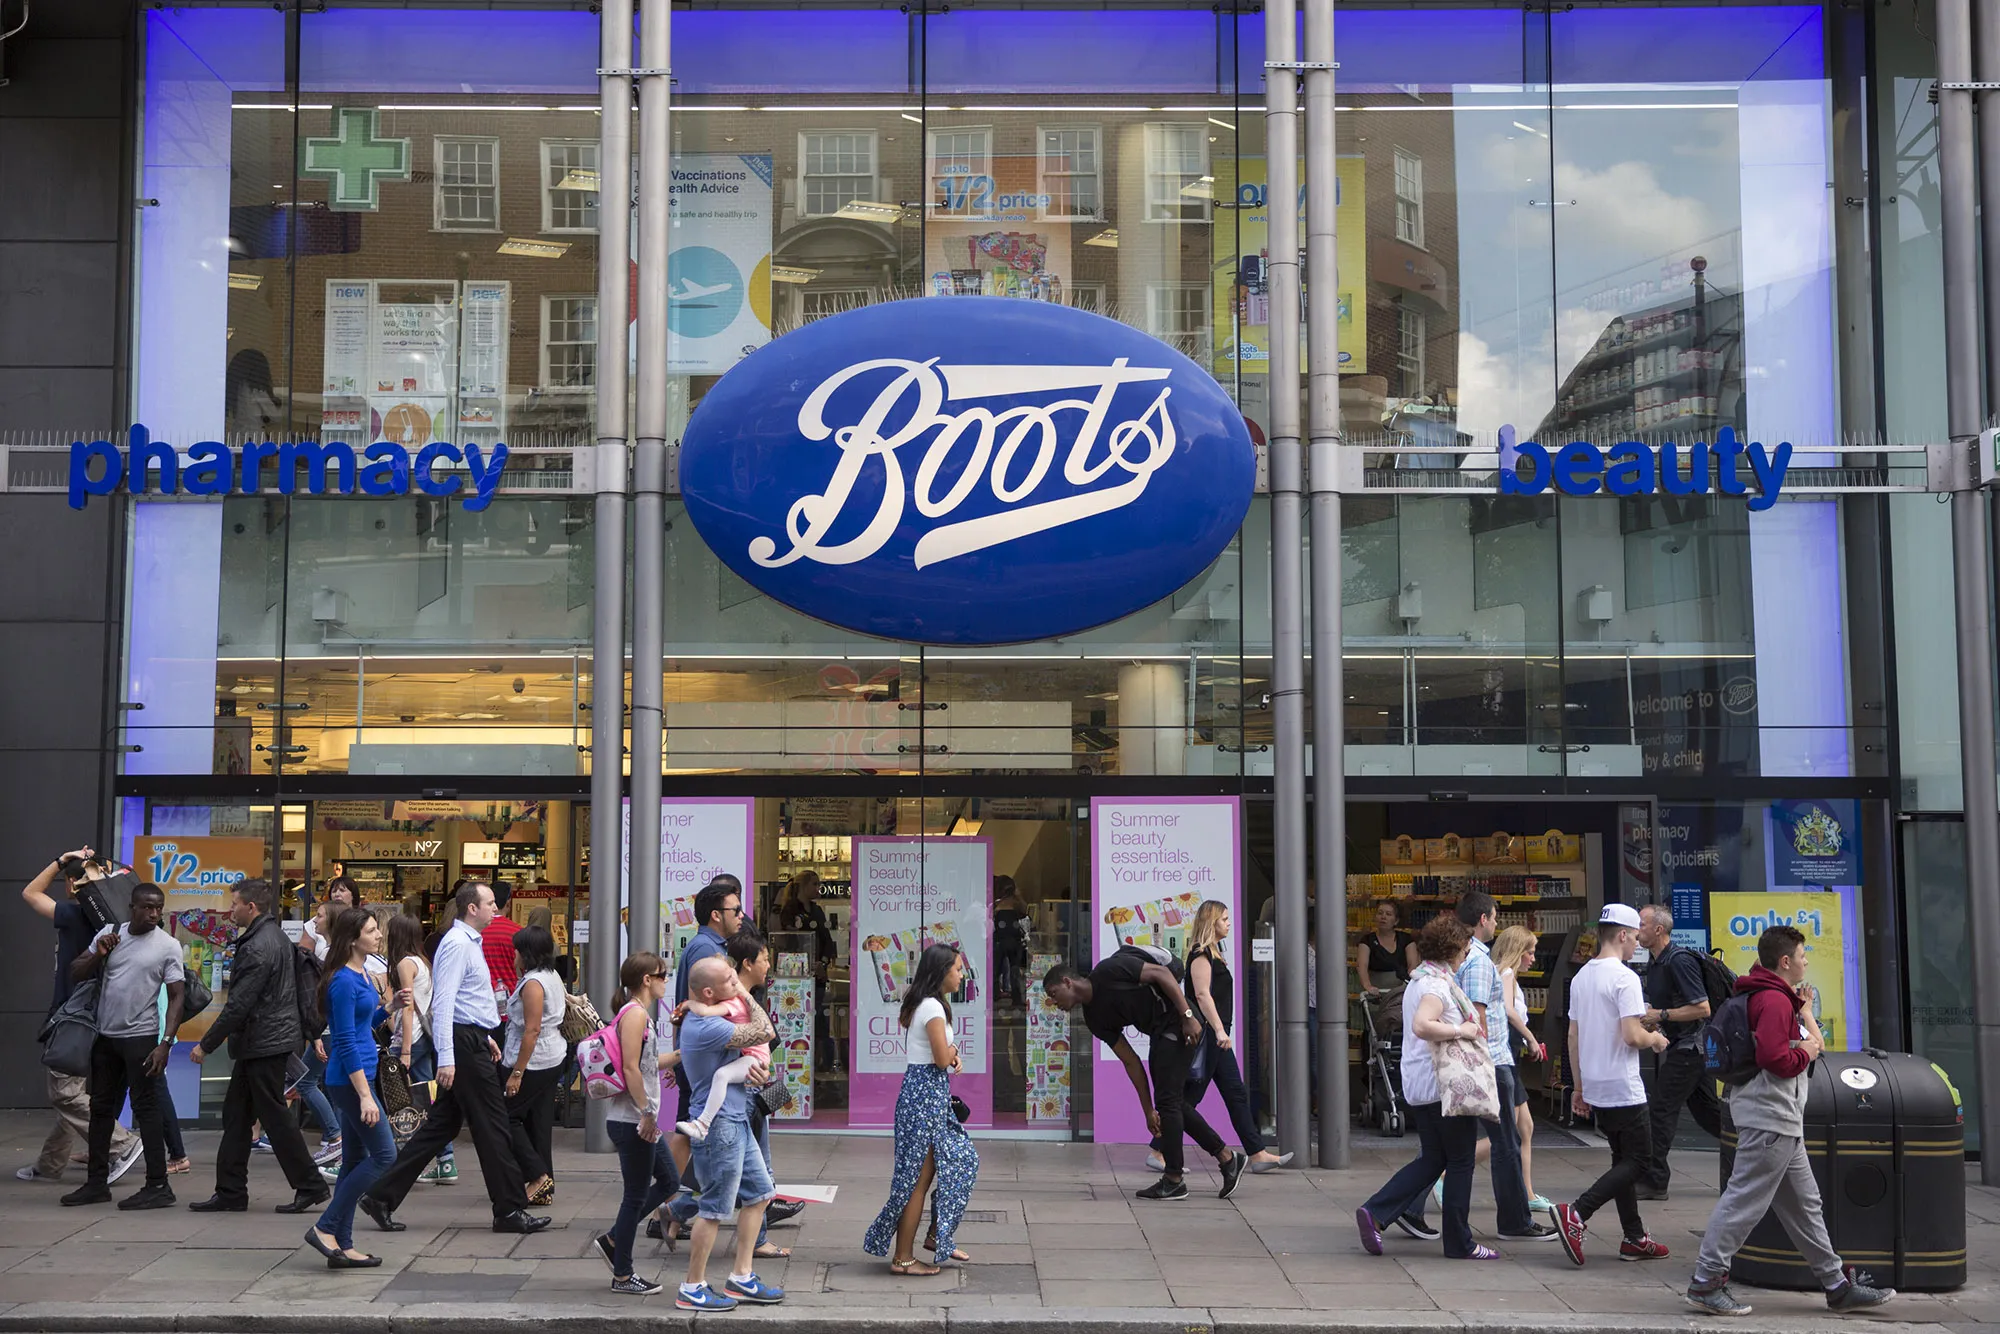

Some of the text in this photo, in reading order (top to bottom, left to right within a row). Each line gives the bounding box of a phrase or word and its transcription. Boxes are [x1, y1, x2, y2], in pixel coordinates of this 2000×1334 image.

[752, 156, 770, 174] new
[944, 165, 969, 174] up to
[671, 170, 746, 181] Vaccinations
[668, 183, 739, 194] ealth Advice
[939, 175, 1051, 212] 1/2 price
[679, 210, 696, 218] safe
[698, 210, 712, 218] and
[714, 210, 742, 220] healthy
[743, 210, 757, 220] trip
[336, 288, 366, 298] new
[383, 329, 410, 337] works
[411, 329, 423, 337] for
[68, 423, 510, 512] pharmacy
[748, 356, 1176, 571] Boots
[1498, 423, 1793, 512] beauty
[1699, 691, 1714, 707] to
[1726, 684, 1754, 706] Boots
[1634, 733, 1685, 746] econd floor
[1642, 748, 1703, 772] by & child
[1110, 811, 1180, 827] Summer
[1632, 808, 1648, 819] first
[1111, 830, 1166, 848] beauty
[1632, 824, 1690, 842] phamacy
[154, 844, 166, 852] up
[869, 849, 930, 864] Summer
[1111, 849, 1194, 864] essentials.
[1662, 850, 1720, 870] Opticians
[149, 853, 245, 886] 1/2 price
[869, 866, 918, 882] beauty
[1110, 866, 1149, 882] Your
[1188, 866, 1216, 886] gift.
[179, 888, 204, 897] holiday
[204, 888, 224, 897] ready
[869, 882, 942, 896] essentials.
[868, 898, 903, 912] Your
[936, 898, 961, 915] gift.
[1796, 910, 1821, 936] £1
[406, 1109, 428, 1122] Rock
